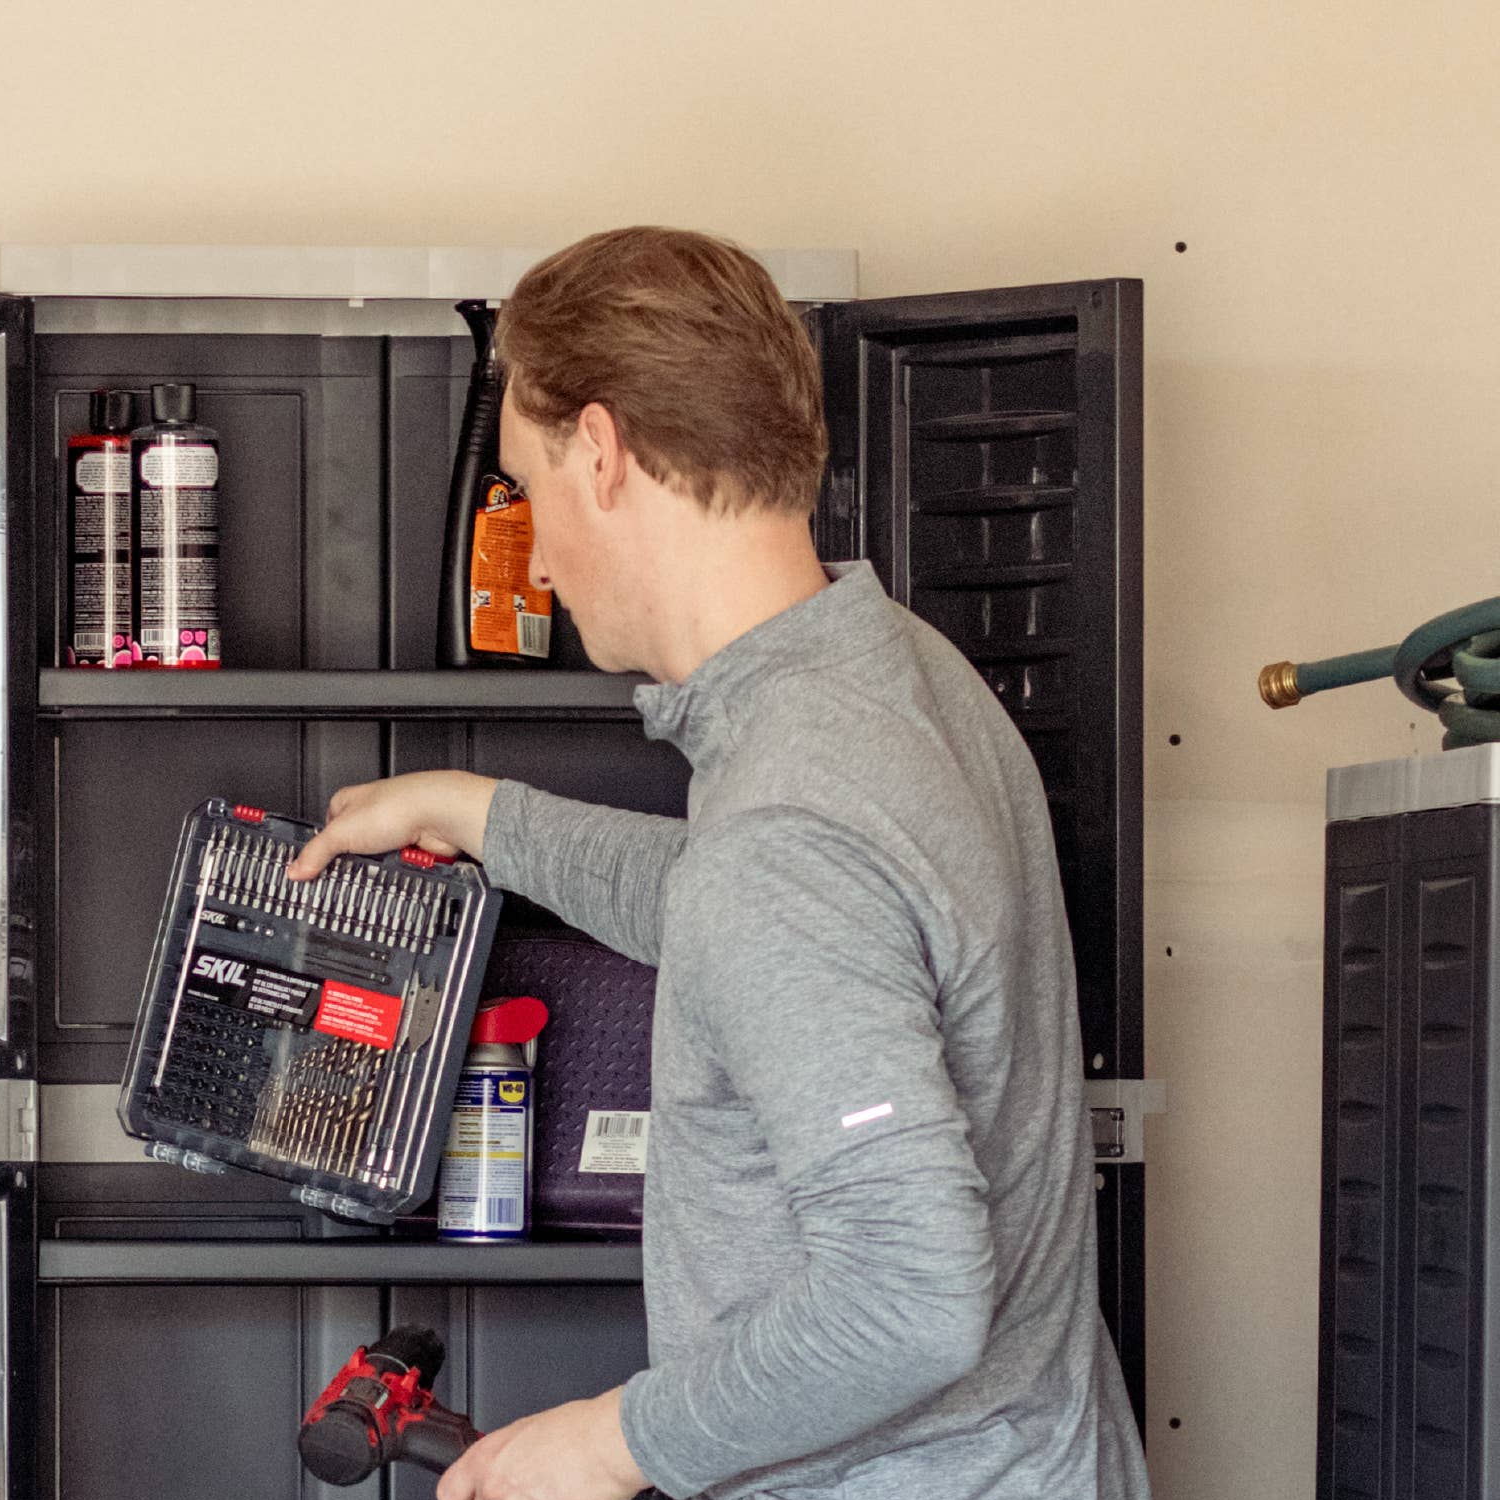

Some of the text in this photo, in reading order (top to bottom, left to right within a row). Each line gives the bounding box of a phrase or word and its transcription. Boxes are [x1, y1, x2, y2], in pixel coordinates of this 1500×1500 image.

[200, 910, 226, 925] SKIL
[192, 955, 248, 987] SKIL
[502, 1084, 523, 1094] WD-40
